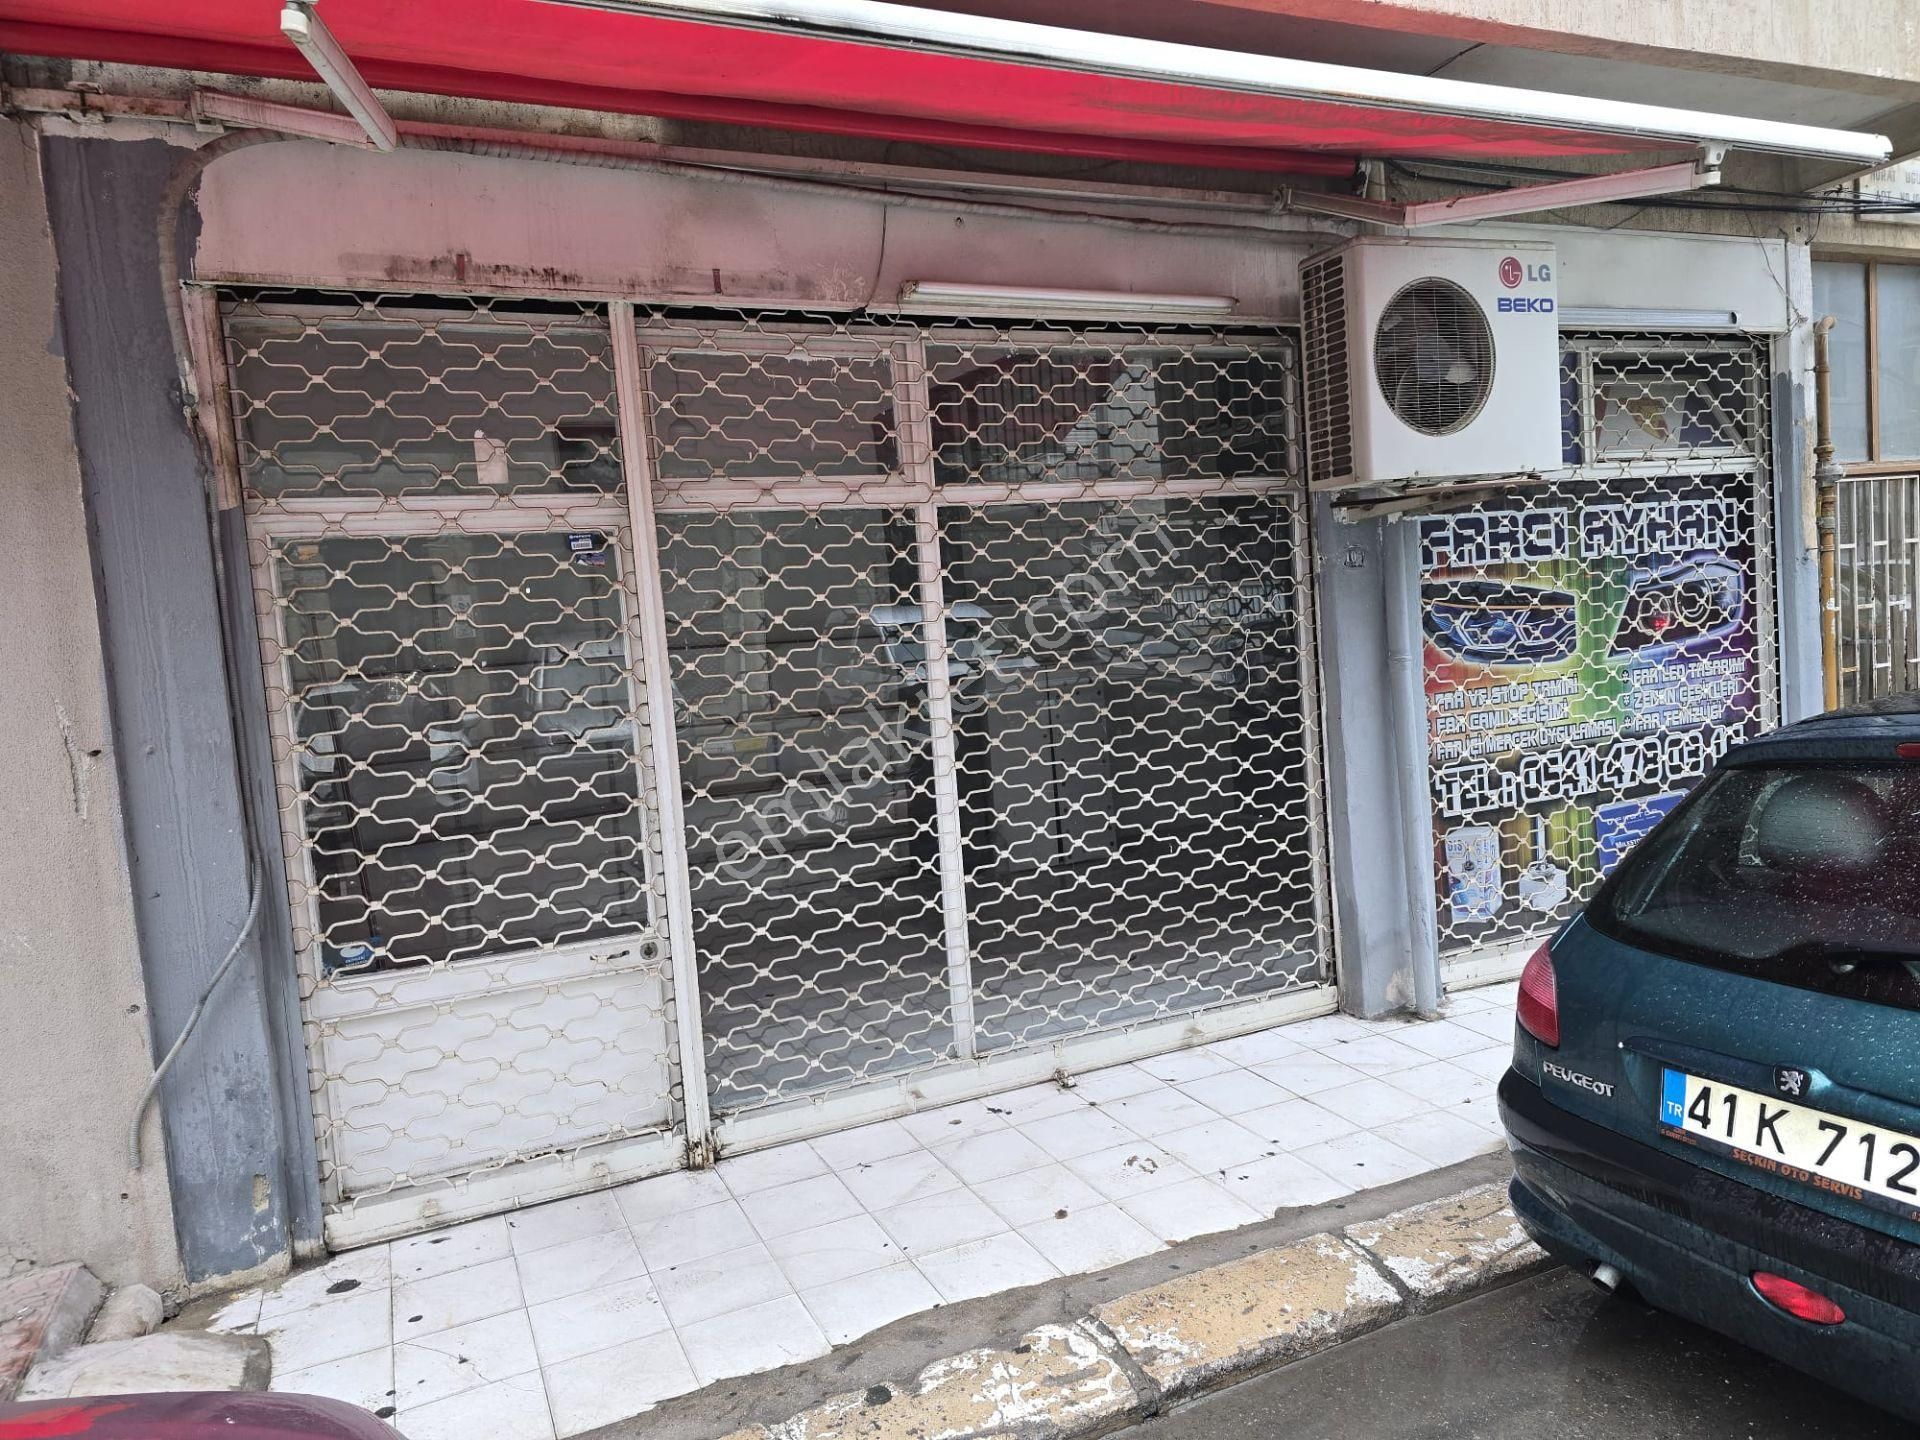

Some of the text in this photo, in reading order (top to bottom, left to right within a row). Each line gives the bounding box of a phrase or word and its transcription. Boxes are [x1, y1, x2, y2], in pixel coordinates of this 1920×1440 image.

[1527, 264, 1551, 282] LG
[1497, 297, 1554, 313] BEKO
[1579, 498, 1739, 557] AYHAN
[1632, 666, 1659, 686] FAR
[1490, 682, 1529, 705] STOP
[1485, 729, 1538, 755] MERCEK
[1543, 1060, 1615, 1097] PEUGEOT
[1666, 1100, 1683, 1118] TR
[1687, 1086, 1920, 1196] 41 K 712
[1780, 1164, 1810, 1182] OTO
